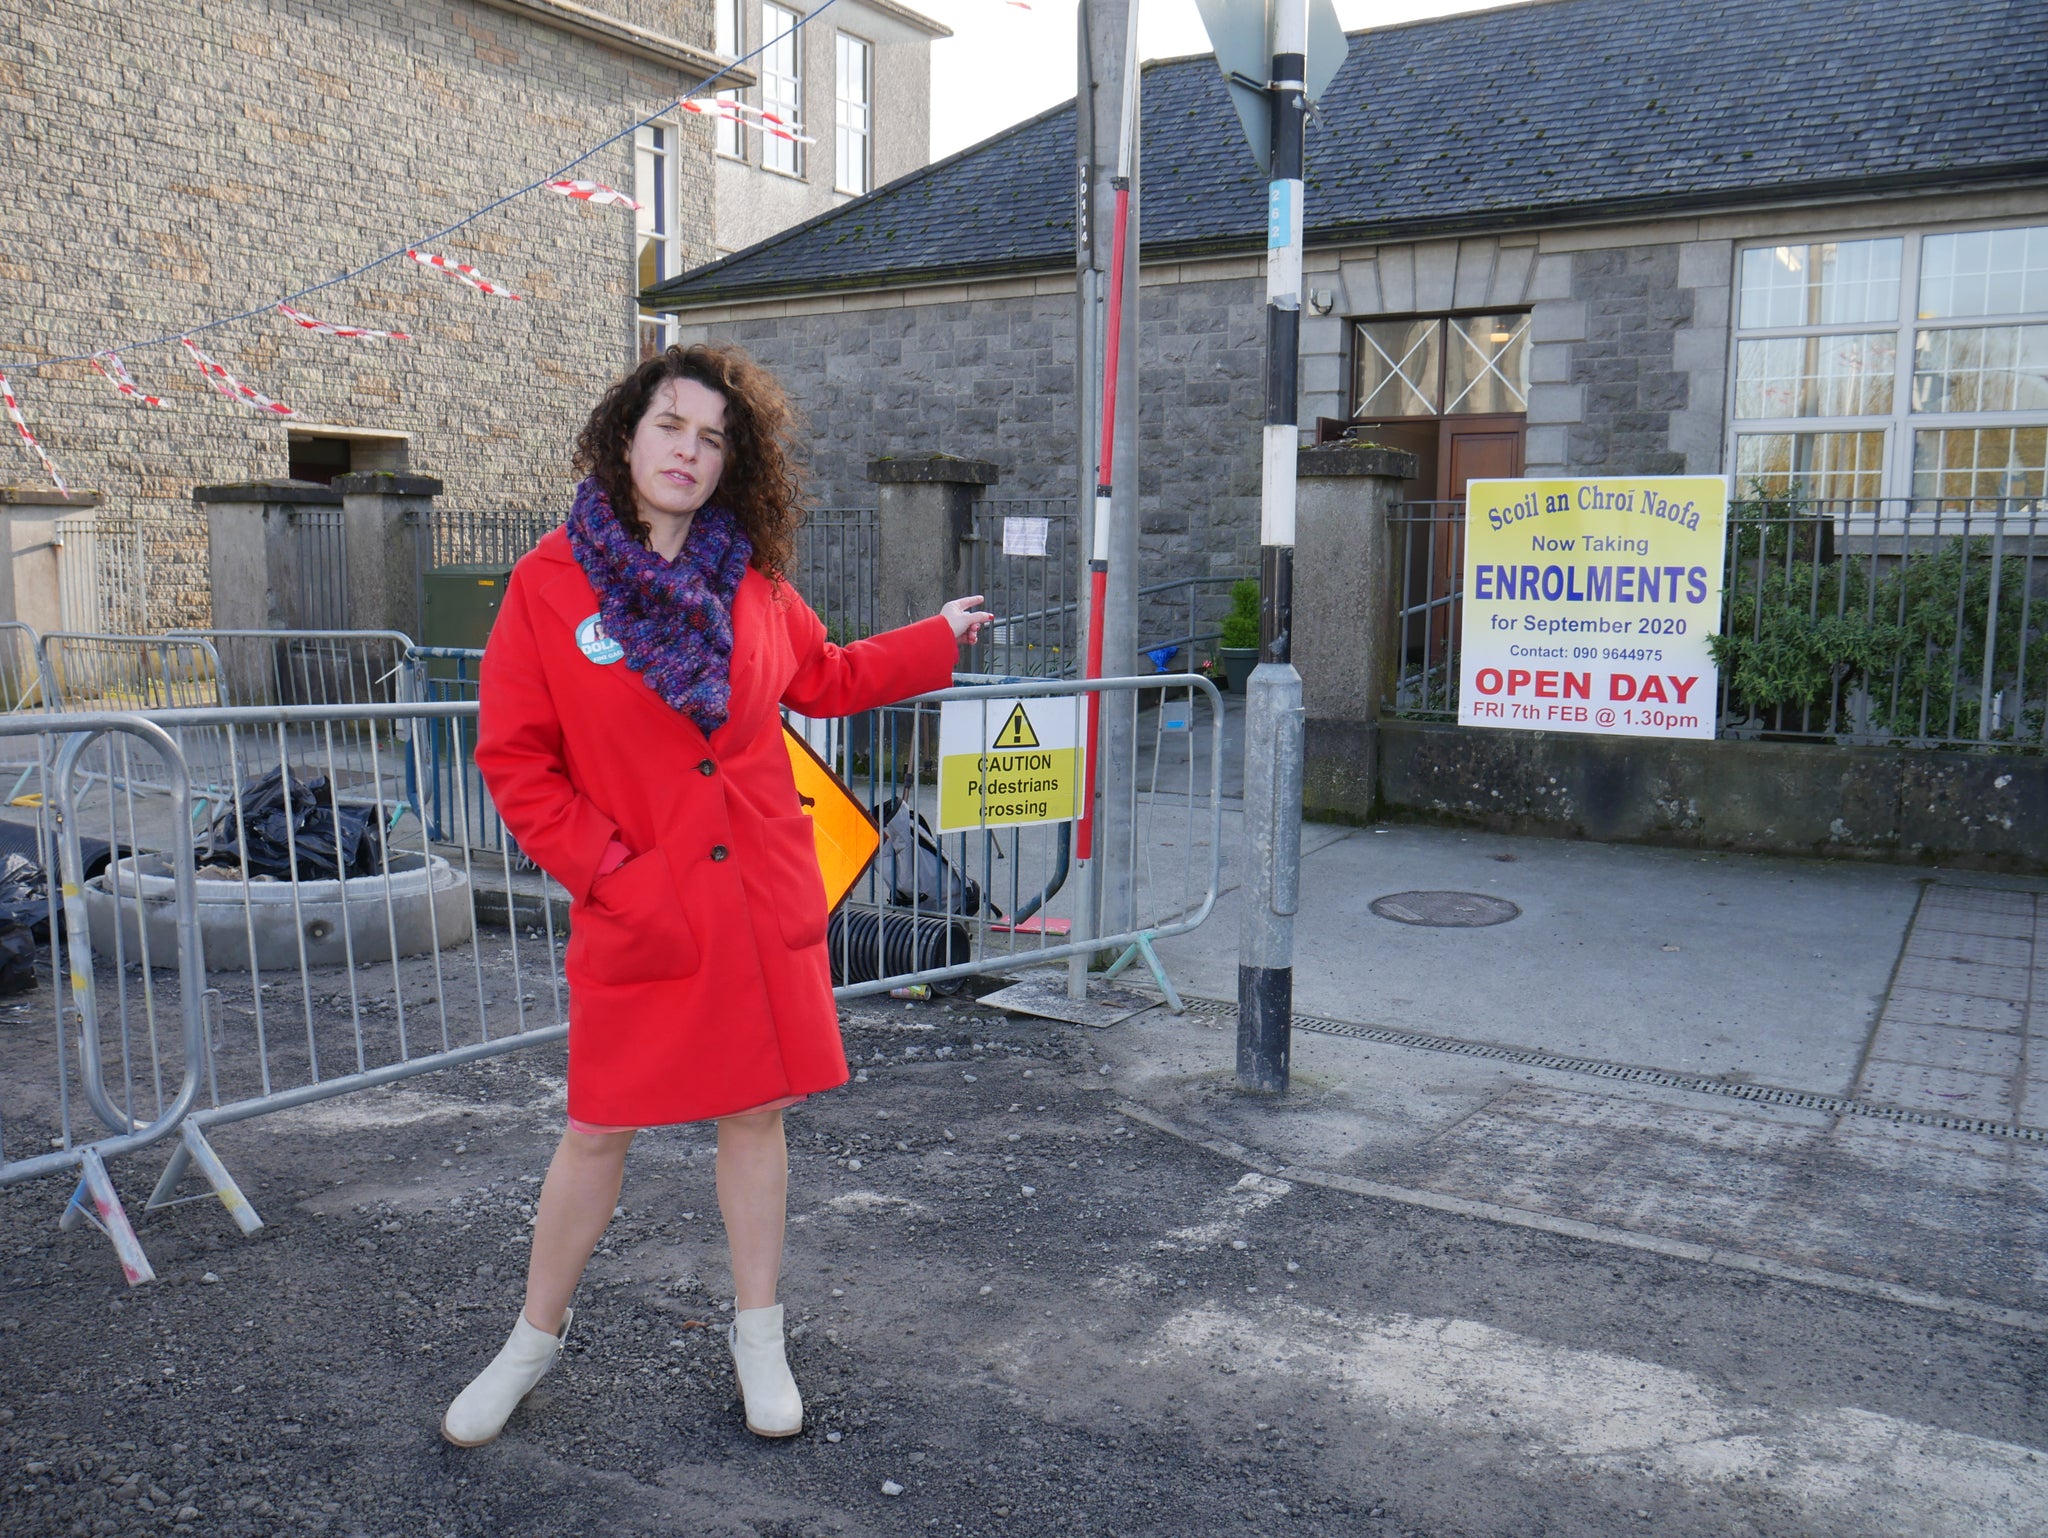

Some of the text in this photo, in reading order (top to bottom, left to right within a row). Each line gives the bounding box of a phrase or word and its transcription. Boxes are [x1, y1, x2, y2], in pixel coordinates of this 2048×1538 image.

[1488, 493, 1539, 531] Scoil
[1545, 492, 1570, 513] an
[1640, 490, 1701, 531] Naofa
[1532, 535, 1650, 555] Now Taking
[1475, 564, 1708, 604] ENROLMENTS
[1491, 614, 1687, 635] for September 2020
[1510, 645, 1663, 662] Contact: 090 9644975
[1475, 668, 1699, 704] OPEN DAY
[1473, 702, 1699, 730] FRI 7th FEB @ 1.30pm
[977, 754, 1052, 773] CAUTION
[968, 778, 1059, 796] Pedestrians
[979, 800, 1047, 817] crossing
